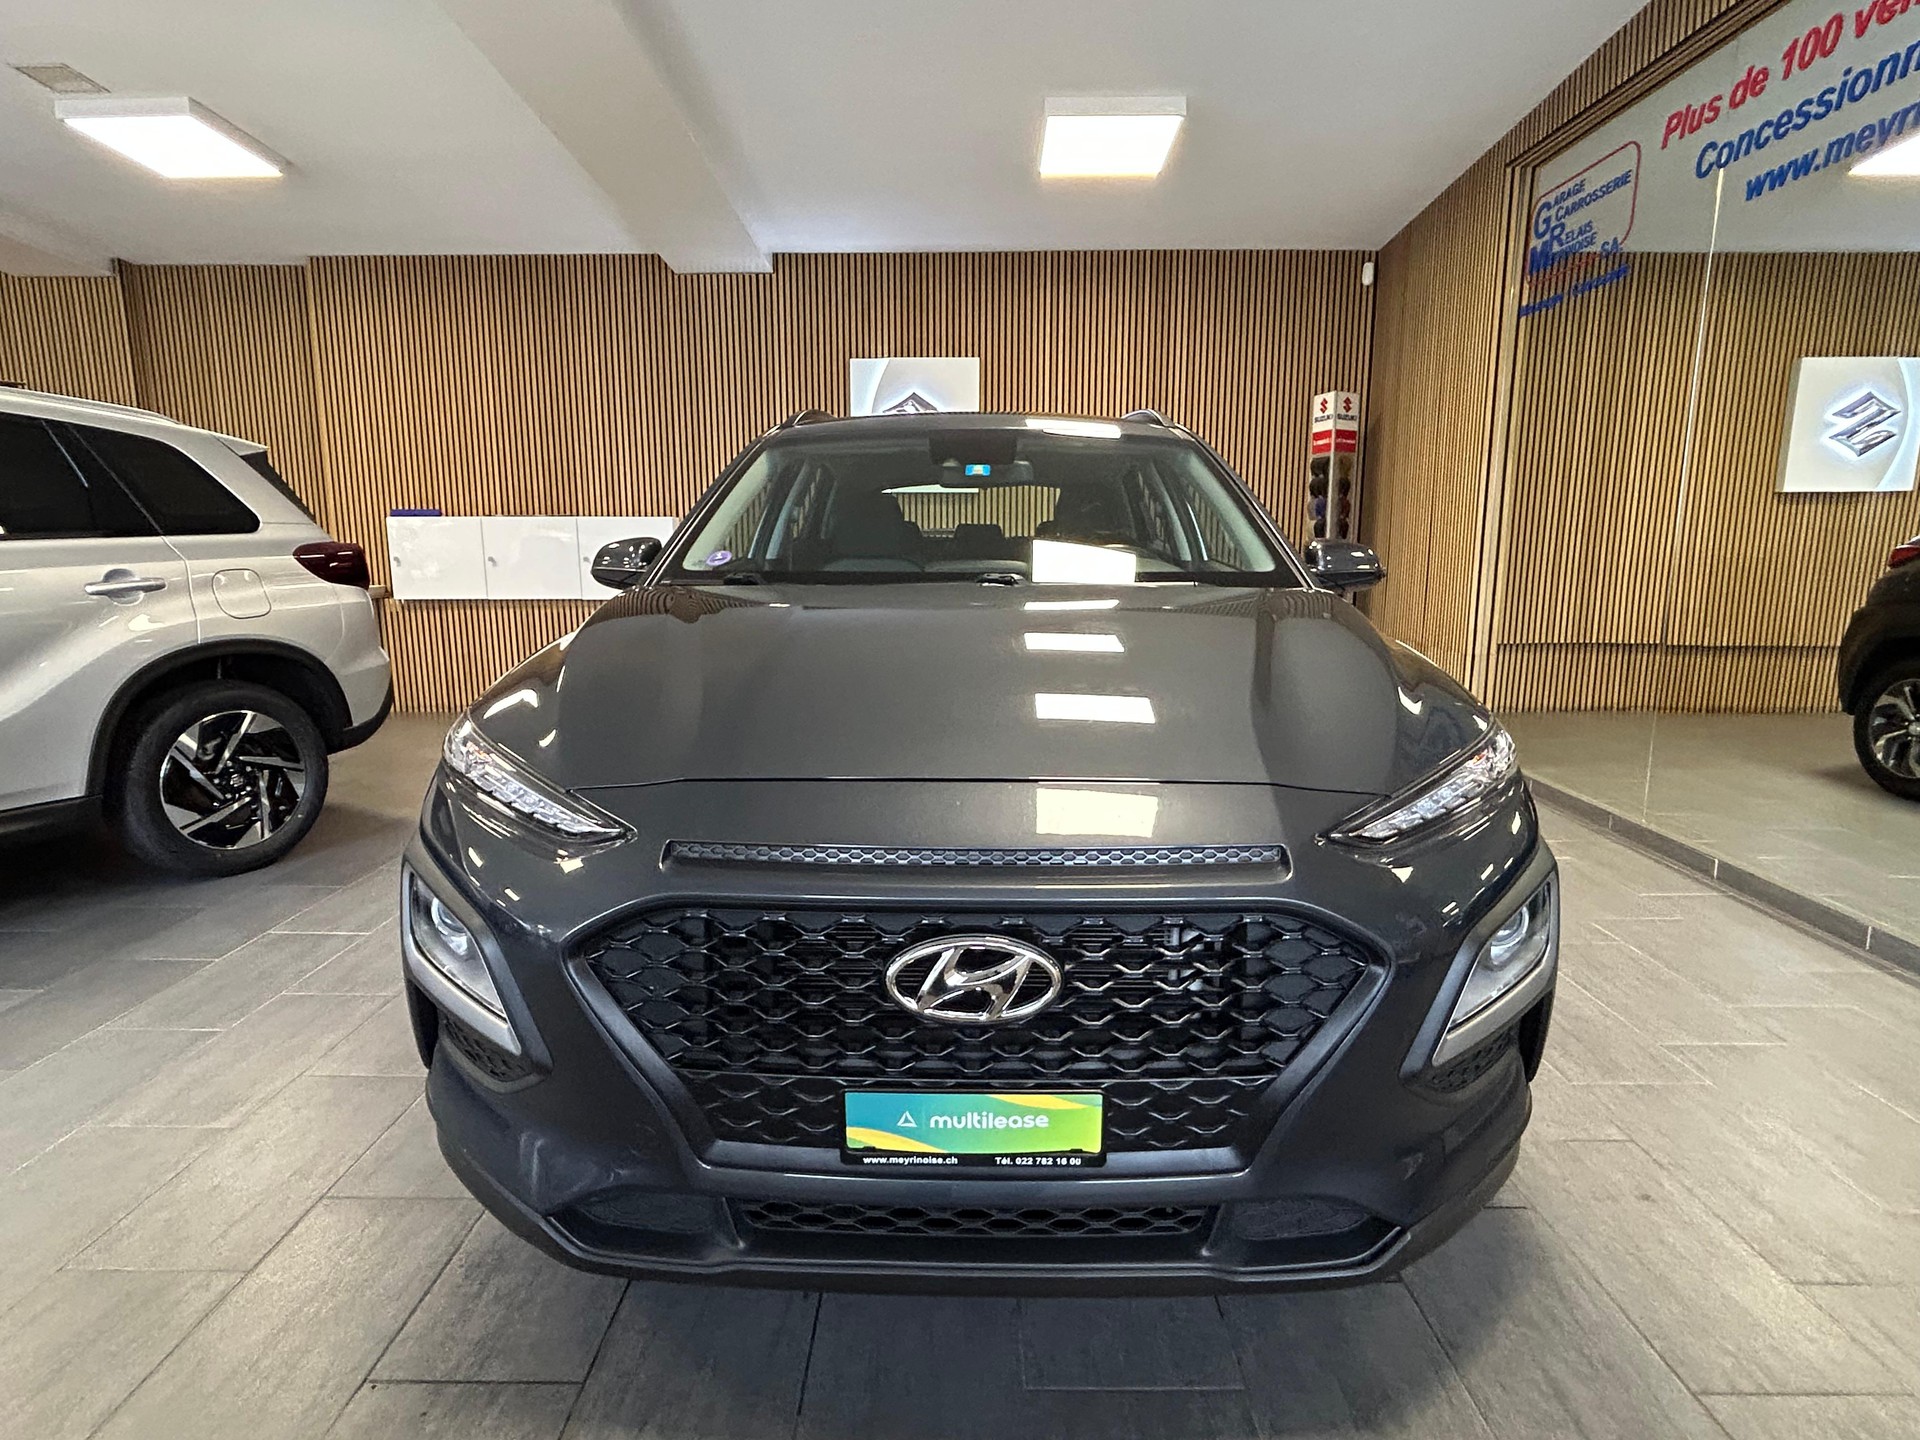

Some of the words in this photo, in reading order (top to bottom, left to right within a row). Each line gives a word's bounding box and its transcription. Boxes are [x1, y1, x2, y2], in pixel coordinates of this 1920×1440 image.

[1661, 94, 1723, 150] Plus
[1729, 65, 1769, 110] de
[1781, 13, 1844, 80] 100
[1554, 169, 1633, 222] CARROSSERIE
[929, 1111, 1049, 1129] multilease
[862, 1155, 959, 1166] www.meyrinoise.ch
[994, 1156, 1014, 1165] Tél.
[1015, 1156, 1033, 1165] 022
[1035, 1157, 1053, 1165] 782
[1069, 1157, 1082, 1166] 00
